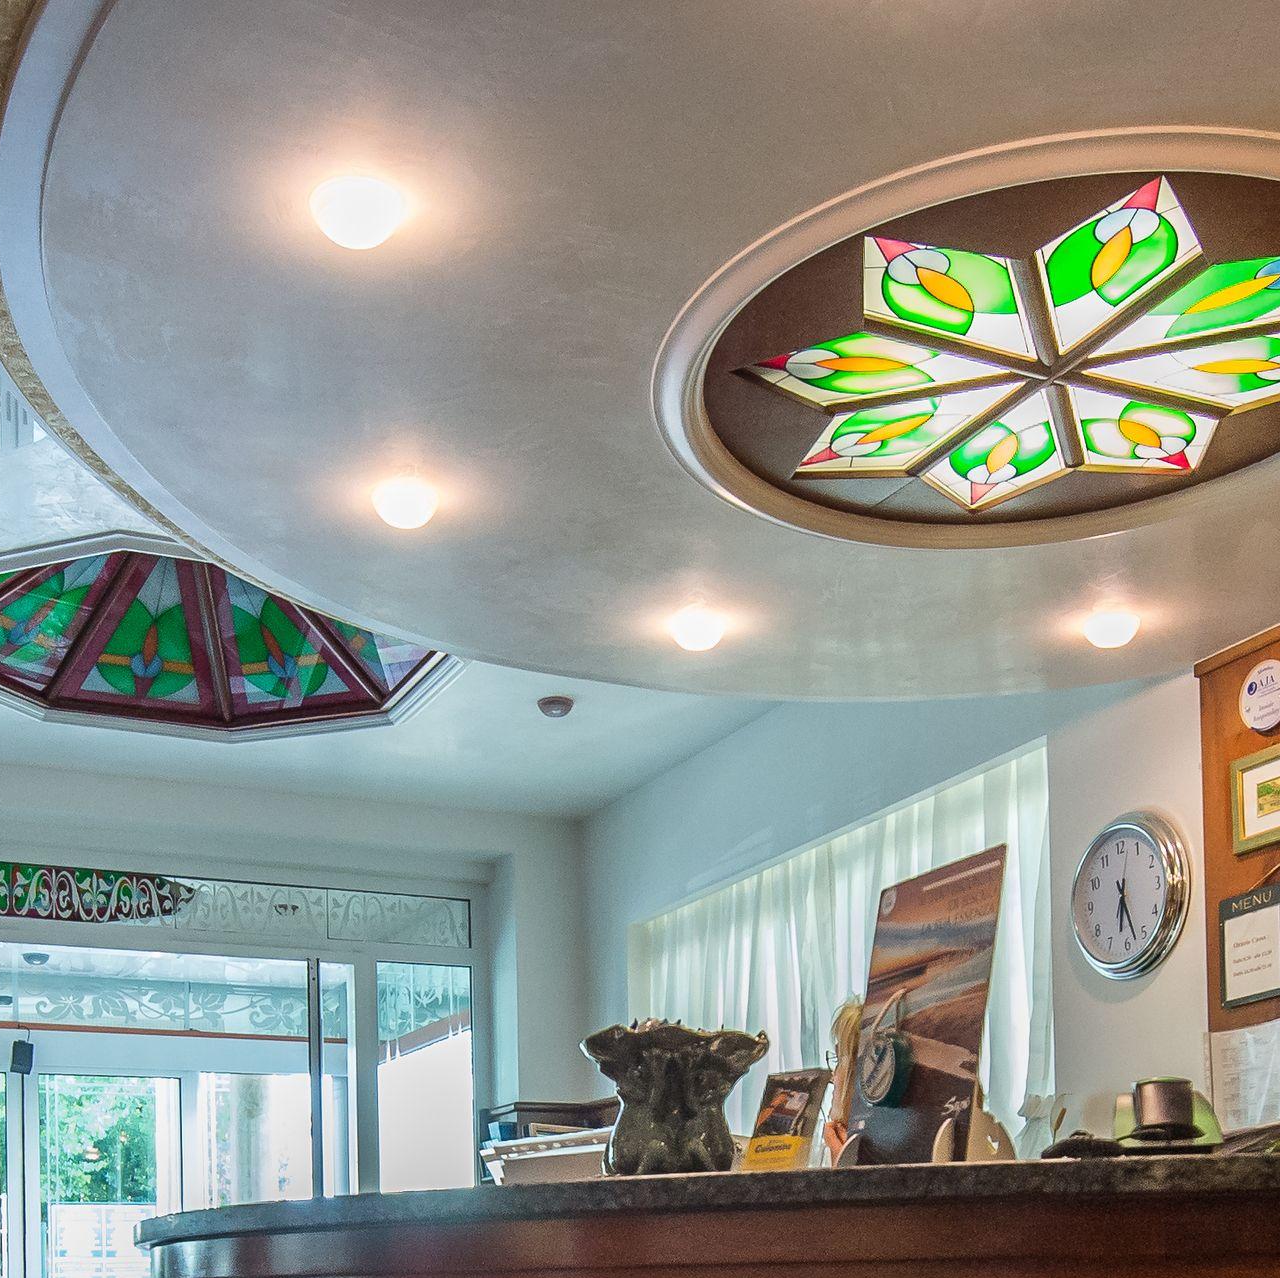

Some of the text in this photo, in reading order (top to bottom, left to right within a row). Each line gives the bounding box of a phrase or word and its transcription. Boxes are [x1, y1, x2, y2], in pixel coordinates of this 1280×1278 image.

[1115, 840, 1125, 855] 12
[1134, 841, 1140, 856] 1
[1100, 854, 1109, 869] 11
[1148, 854, 1155, 869] 2
[1090, 876, 1101, 891] 10
[1154, 875, 1161, 890] 3
[1087, 901, 1094, 916] 9
[1231, 890, 1272, 913] MENU
[1151, 903, 1159, 916] 4
[1094, 924, 1102, 938] 8
[1141, 925, 1147, 940] 5
[1107, 937, 1113, 952] 7
[1124, 936, 1131, 951] 6
